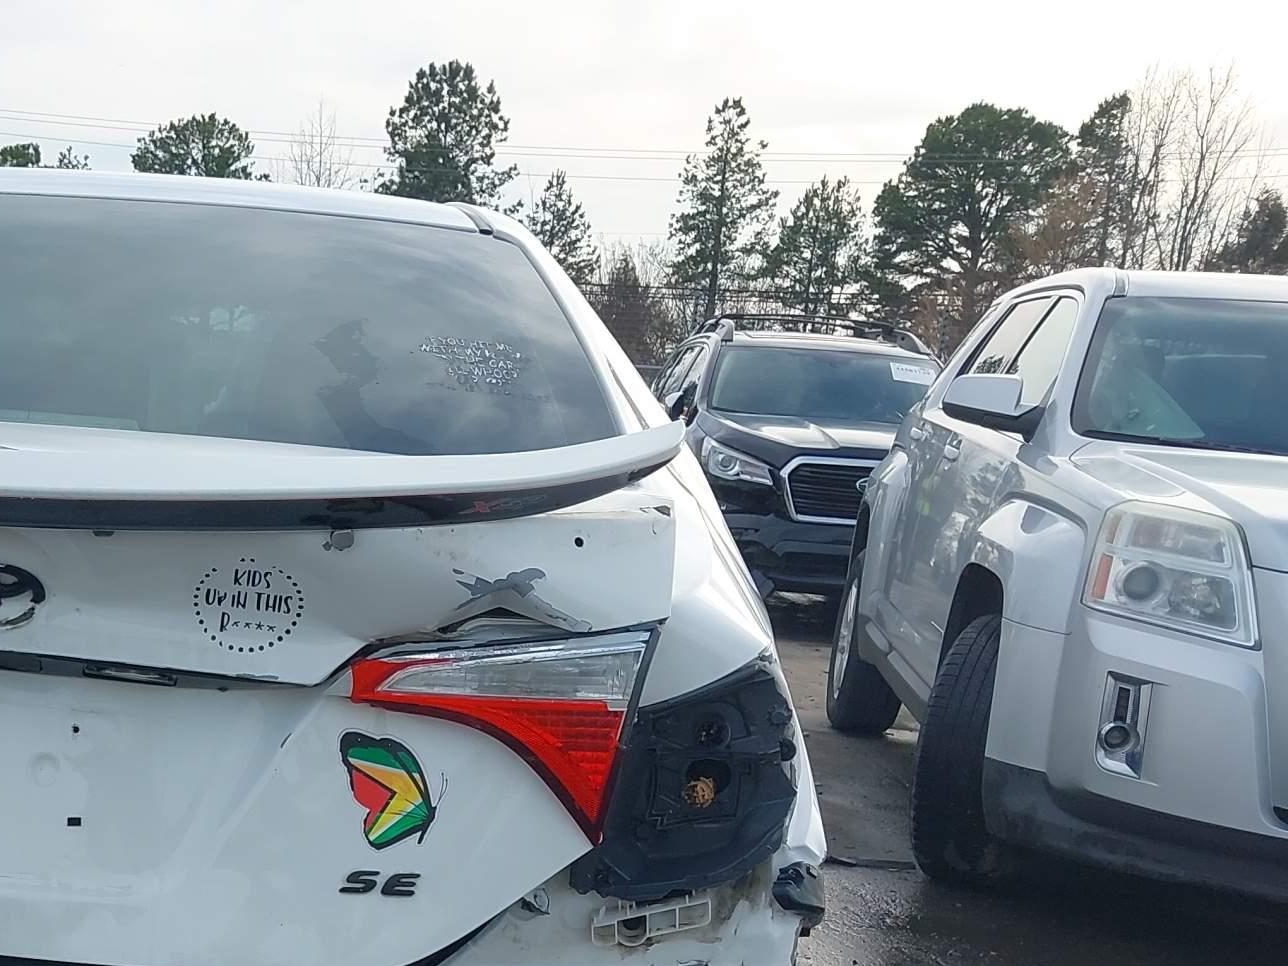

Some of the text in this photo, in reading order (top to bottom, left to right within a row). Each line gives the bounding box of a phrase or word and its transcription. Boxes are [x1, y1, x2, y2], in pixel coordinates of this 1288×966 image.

[233, 568, 273, 590] KIDS
[230, 590, 248, 610] IN
[254, 591, 294, 615] THIS
[338, 870, 422, 897] SE
